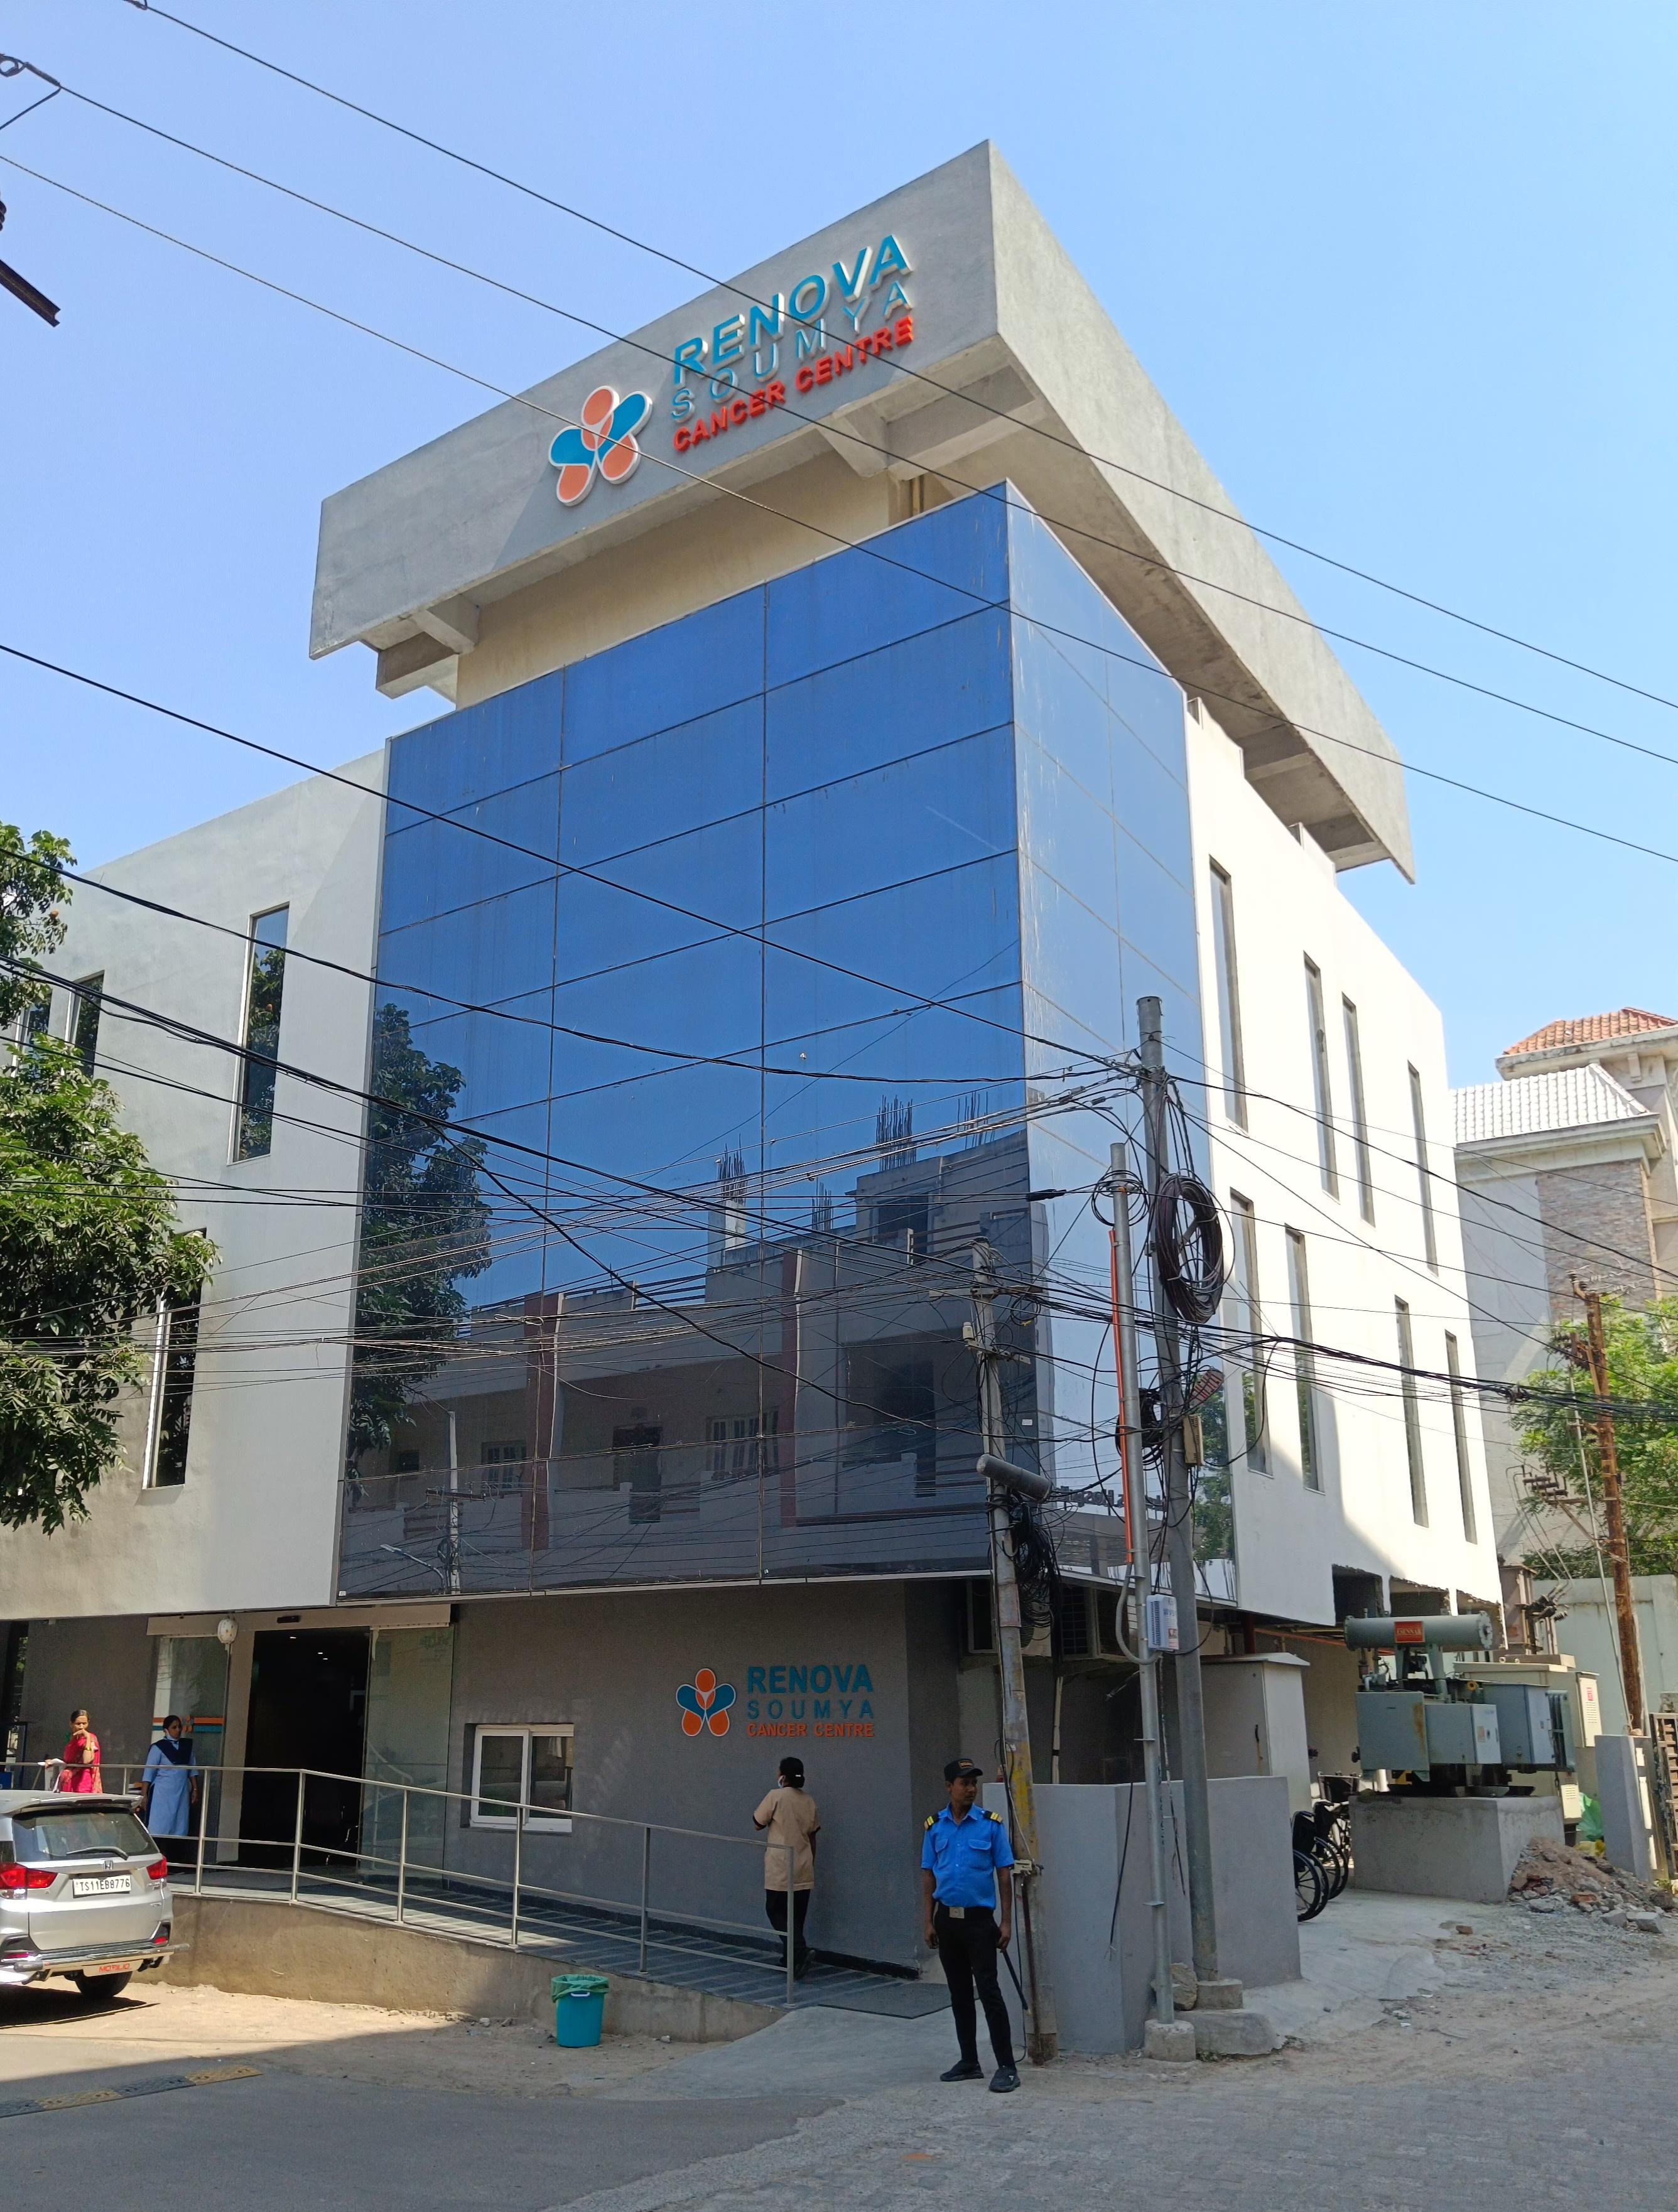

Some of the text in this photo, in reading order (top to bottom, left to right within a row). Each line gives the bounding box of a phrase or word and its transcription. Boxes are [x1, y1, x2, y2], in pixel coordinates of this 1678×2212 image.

[674, 234, 914, 388] RENOVA
[671, 281, 914, 423] SOUMYA
[673, 315, 914, 452] CANCER CENTRE
[747, 1664, 874, 1694] RENOVA
[746, 1699, 874, 1719] SOUMYA
[747, 1723, 874, 1737] CANCER CENTRE
[79, 1878, 130, 1892] TS11EB8776
